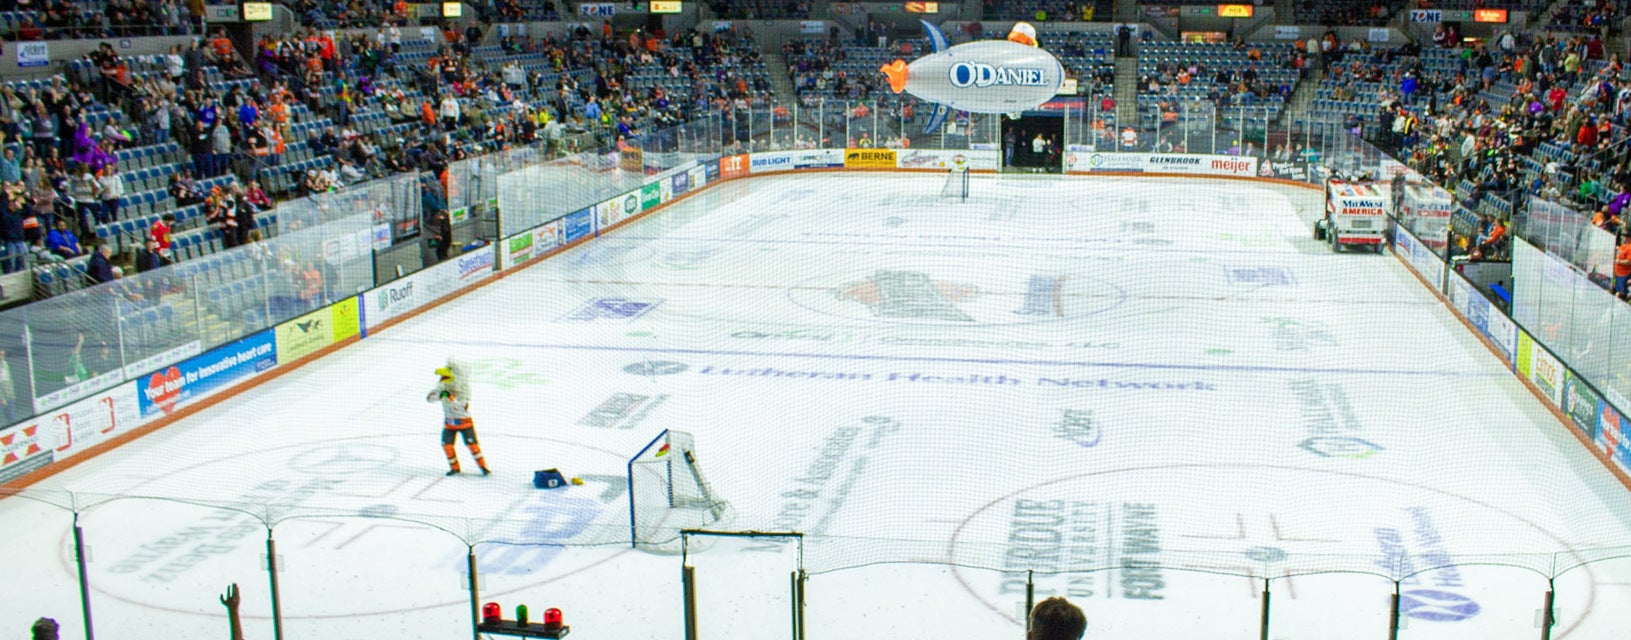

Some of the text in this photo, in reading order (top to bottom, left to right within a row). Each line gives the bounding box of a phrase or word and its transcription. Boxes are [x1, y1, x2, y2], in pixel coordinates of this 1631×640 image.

[949, 60, 1049, 88] O'DANIEL
[752, 159, 766, 167] BUD
[768, 157, 791, 166] LIGHT
[861, 152, 894, 161] BERNE
[1149, 156, 1201, 164] GLENBROOK
[1211, 157, 1251, 173] meijer
[1342, 208, 1383, 216] AMERICA
[389, 281, 414, 303] Ruoff
[144, 384, 165, 401] Your
[186, 370, 199, 384] for
[887, 373, 1021, 386] Health
[1038, 377, 1217, 392] Network
[998, 498, 1066, 596] PURDUE
[1066, 500, 1098, 598] UNIVERSITY
[1119, 501, 1166, 600] FORT WAYNE
